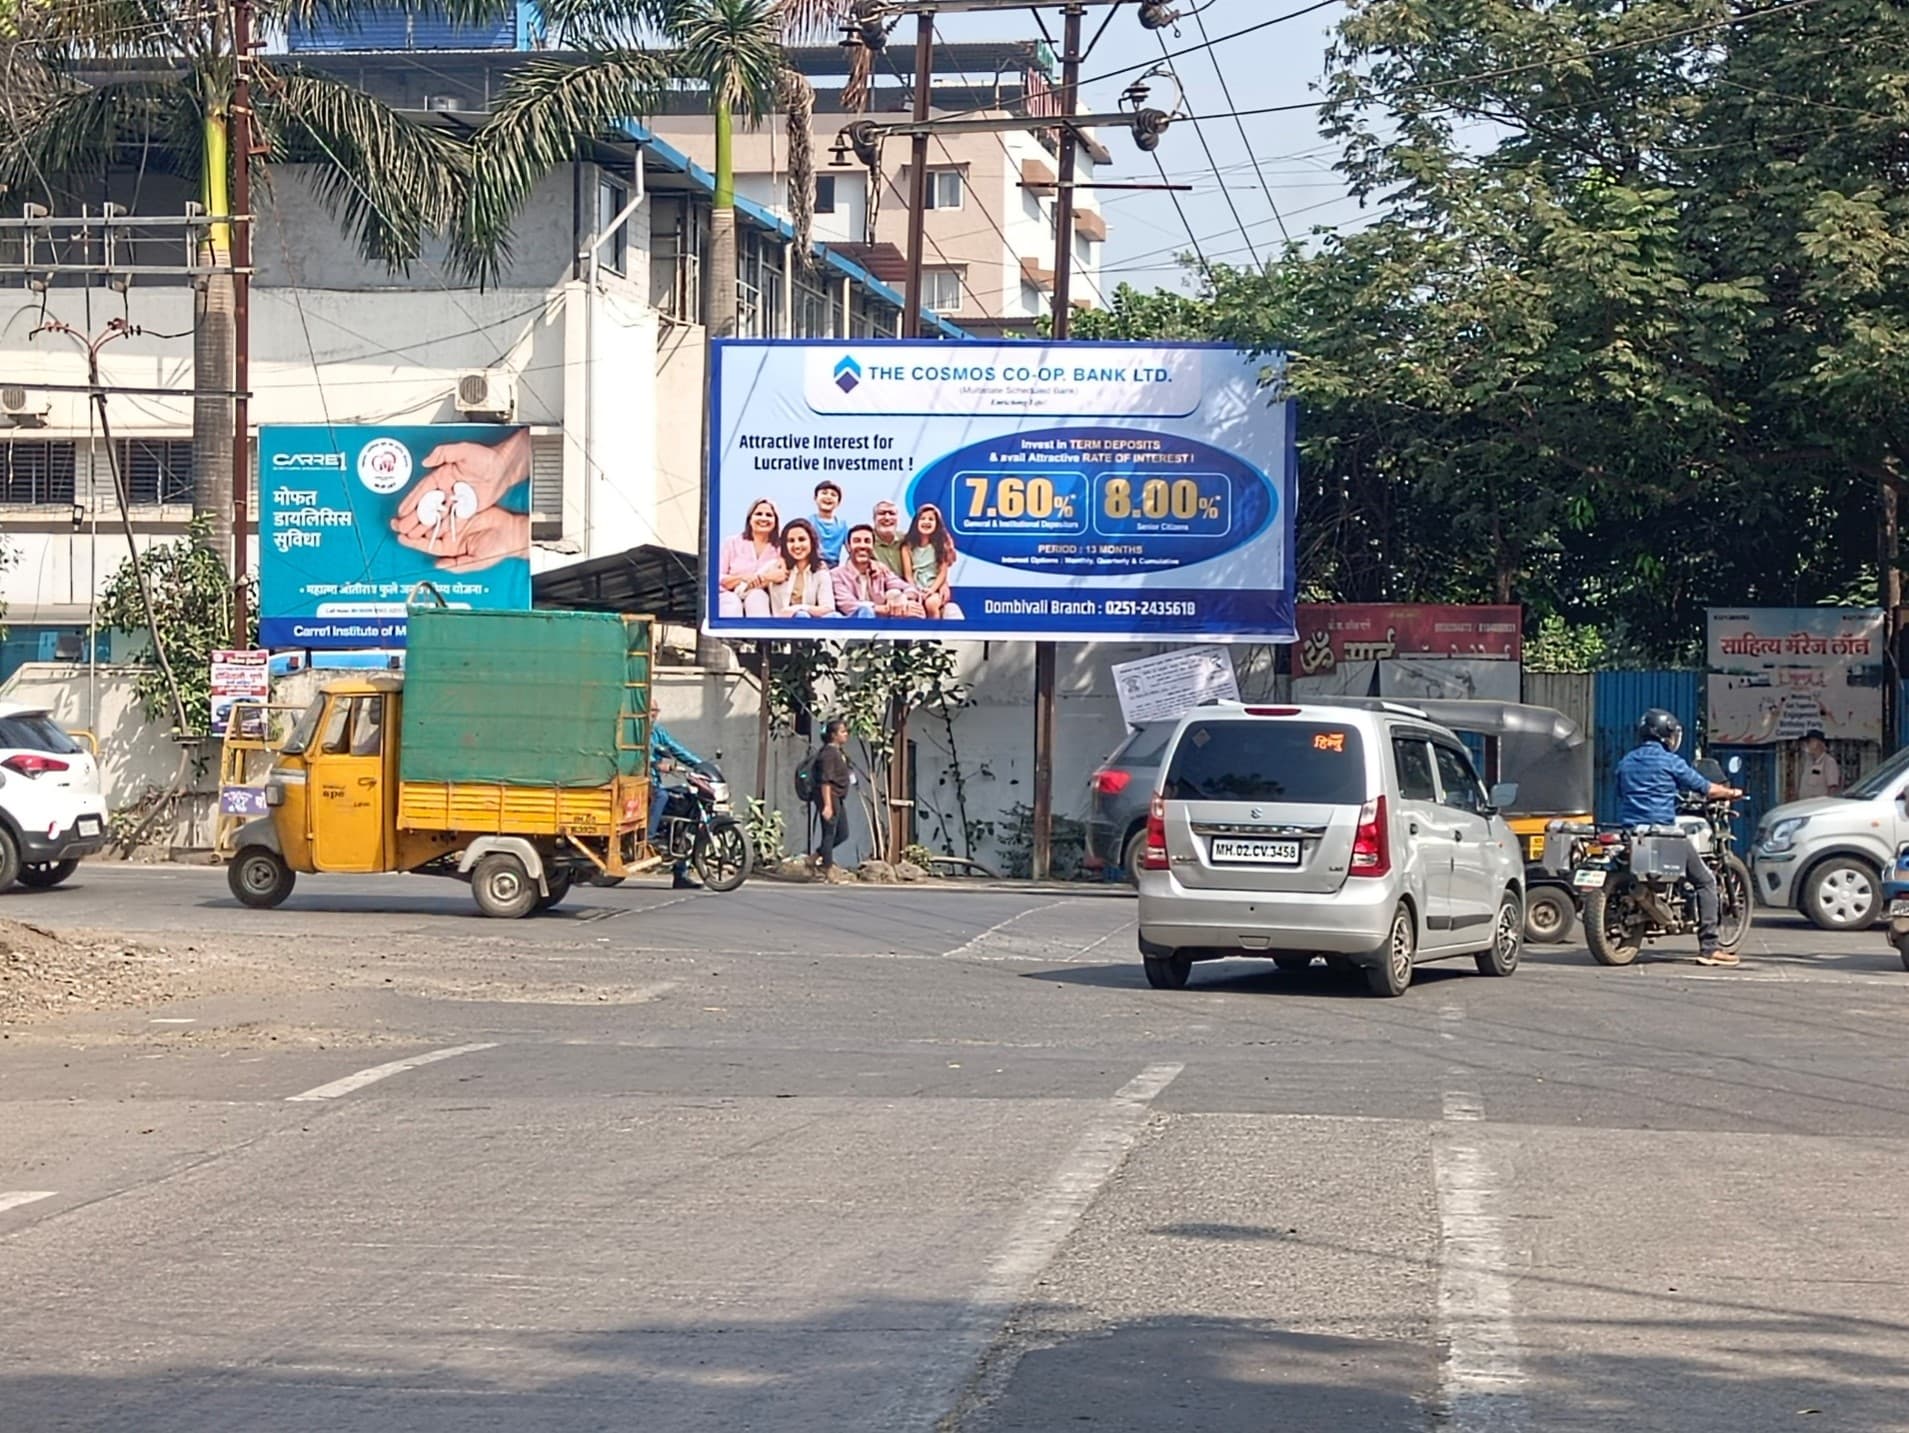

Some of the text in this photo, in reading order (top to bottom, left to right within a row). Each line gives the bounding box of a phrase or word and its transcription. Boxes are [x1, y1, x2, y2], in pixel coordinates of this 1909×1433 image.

[868, 367, 904, 381] THE
[912, 366, 995, 381] COSMOS
[1073, 368, 1126, 382] BANK
[1133, 368, 1172, 383] LTD.
[739, 434, 894, 449] Attractive Interest for
[1021, 439, 1161, 450] Invest in TERM DEPOSITS
[754, 456, 819, 471] Lucrative
[823, 456, 903, 471] Investment
[989, 452, 998, 462] &
[1000, 453, 1026, 462] avail
[1028, 452, 1080, 463] Attractive
[1082, 453, 1112, 463] RATE
[1115, 453, 1131, 463] OF
[1133, 453, 1189, 463] INTEREST
[272, 486, 317, 506] मोफत
[272, 507, 352, 527] डायलिसिस
[272, 529, 321, 552] सुविधा
[1038, 544, 1077, 554] PERIOD
[1086, 545, 1097, 554] 13
[1099, 545, 1143, 554] MONTHS
[984, 599, 1048, 615] Dombivali
[1051, 600, 1096, 615] Branch
[1105, 600, 1196, 616] 0251-2435618
[332, 625, 379, 637] Institute
[381, 625, 393, 637] of
[1720, 632, 1781, 657] साहित्य
[1831, 632, 1870, 656] लॉन
